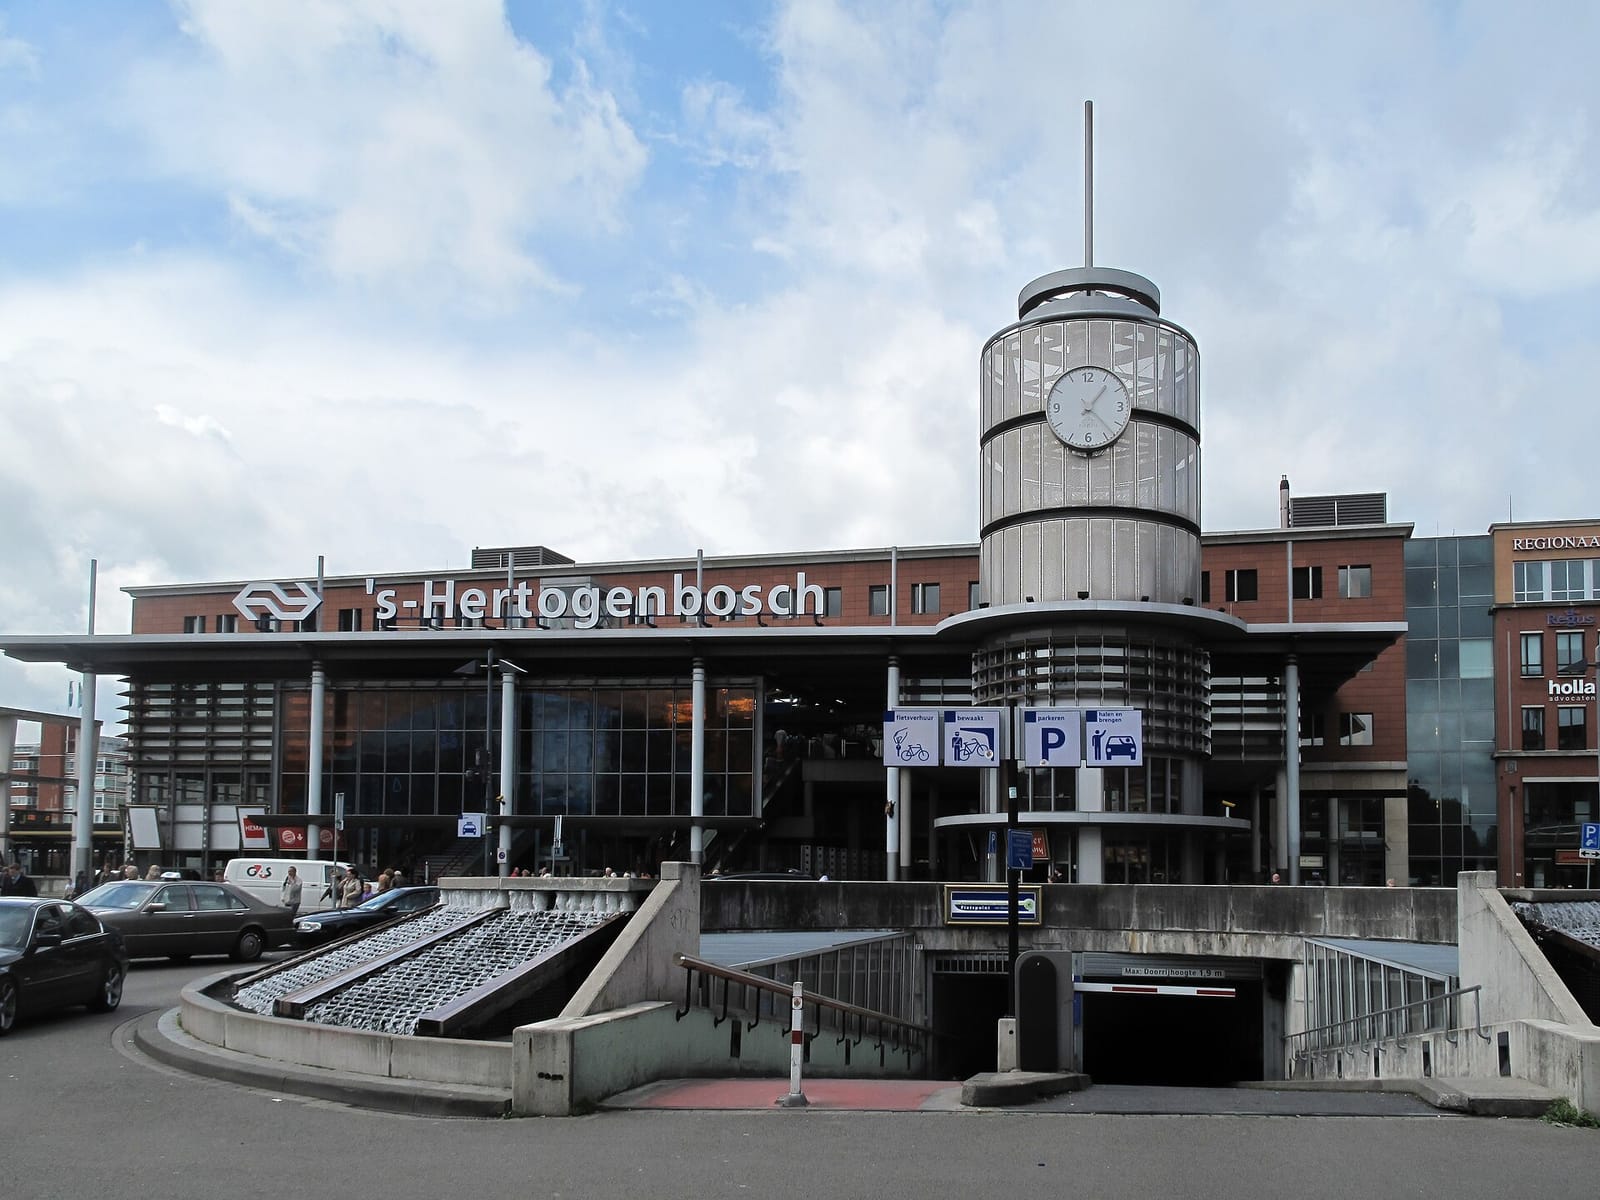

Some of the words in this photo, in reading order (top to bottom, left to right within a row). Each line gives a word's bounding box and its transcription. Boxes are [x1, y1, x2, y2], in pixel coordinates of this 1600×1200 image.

[1082, 373, 1094, 382] 12
[1053, 403, 1061, 413] 9
[1116, 402, 1124, 412] 3
[1085, 433, 1092, 442] 6
[366, 571, 824, 629] 's-Hertogenbosch
[1546, 613, 1594, 627] Regus
[1548, 680, 1596, 695] holla
[1041, 727, 1066, 760] P
[1586, 826, 1596, 838] P
